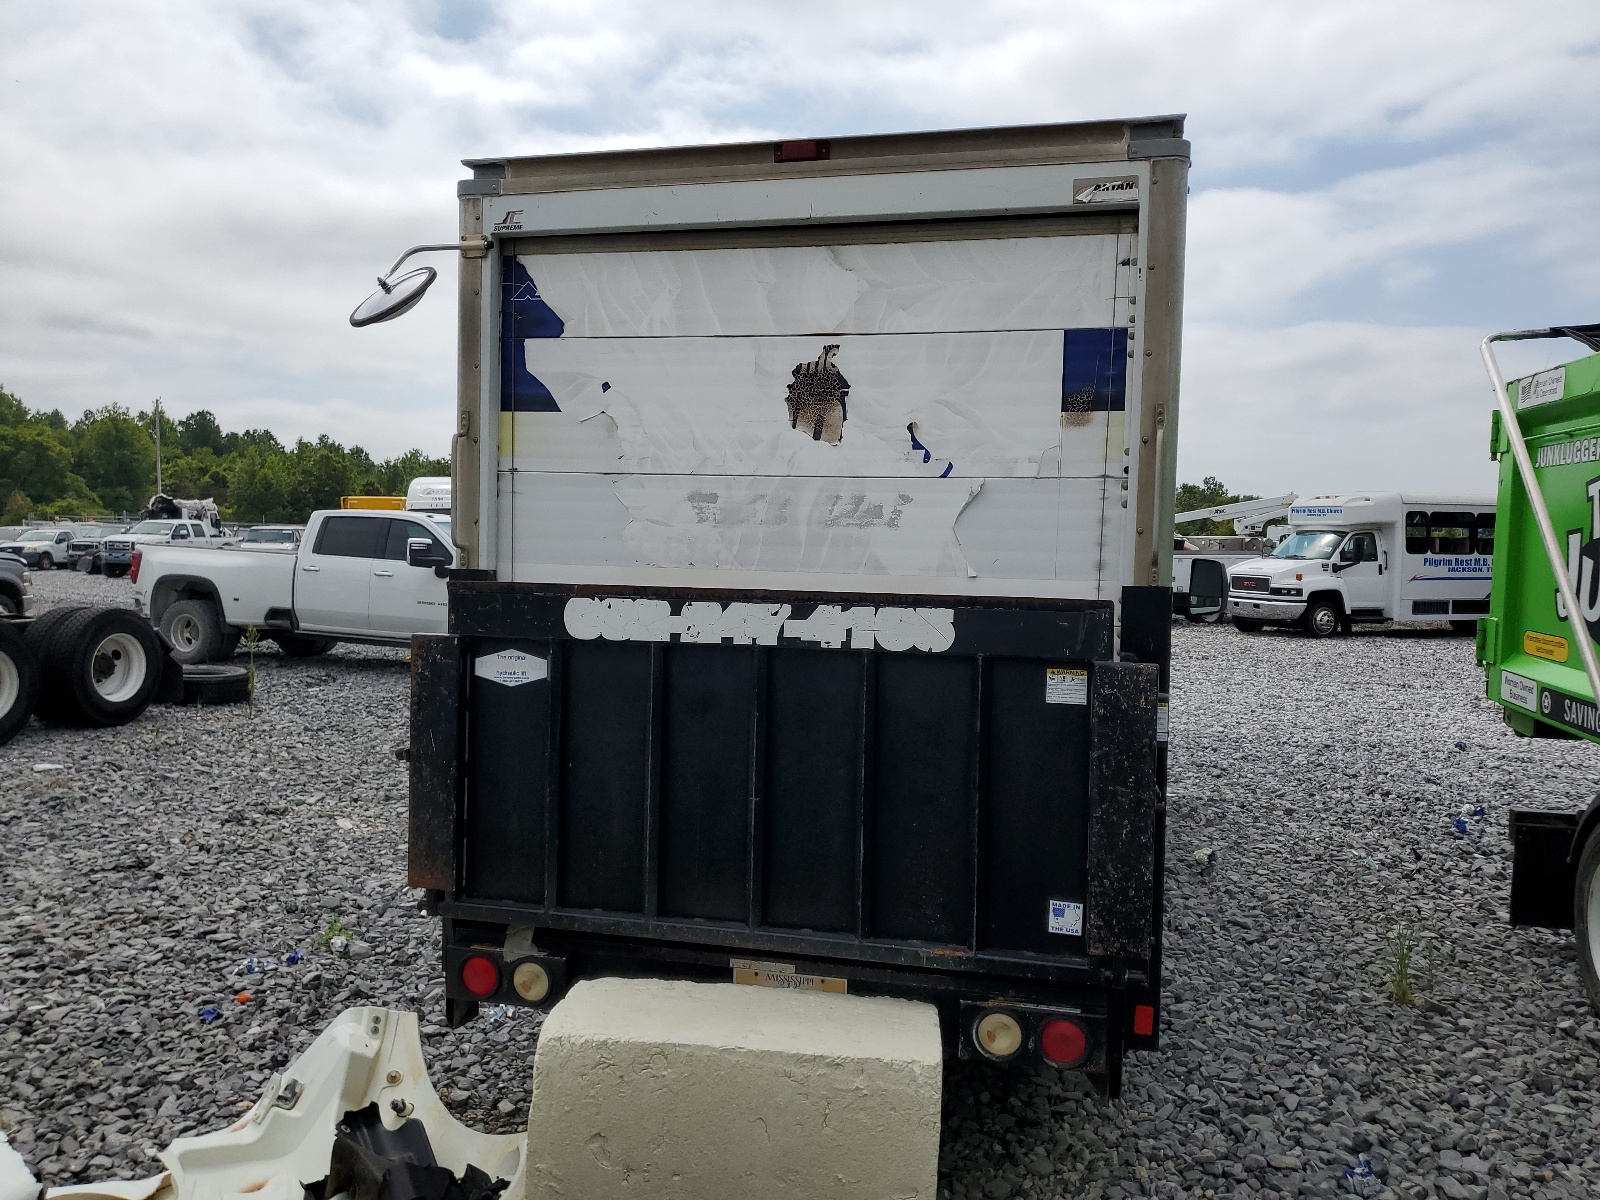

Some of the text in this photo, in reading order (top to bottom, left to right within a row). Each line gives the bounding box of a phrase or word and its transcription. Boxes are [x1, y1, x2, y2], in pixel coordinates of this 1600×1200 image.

[493, 224, 524, 232] SUPREME
[1423, 557, 1490, 568] Pilgrim Rest M.B.
[1509, 688, 1528, 704] Business
[765, 973, 815, 986] MISSISSIPPI
